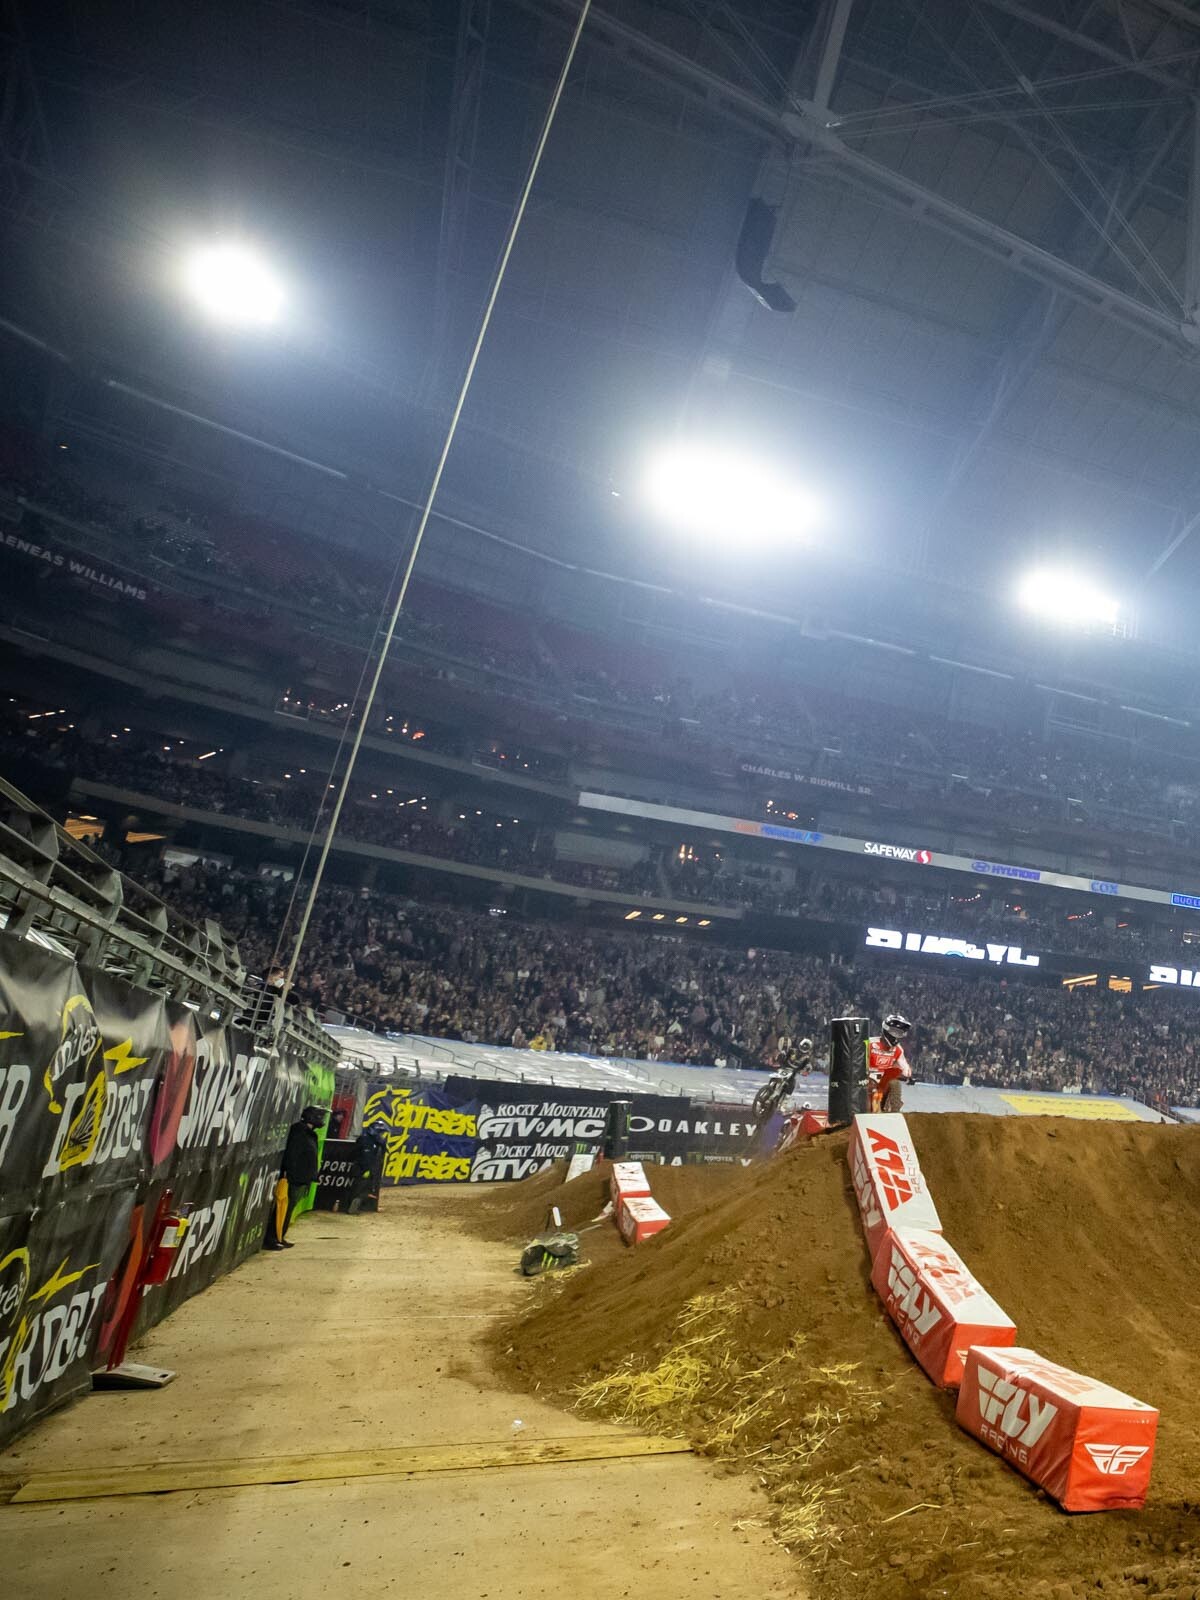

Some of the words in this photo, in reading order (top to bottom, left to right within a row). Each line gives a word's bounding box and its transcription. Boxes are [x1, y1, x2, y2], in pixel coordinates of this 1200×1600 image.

[69, 560, 147, 601] WILLIAMS
[741, 763, 791, 780] CHARLES
[863, 842, 917, 861] SAFEWAY
[991, 864, 1041, 881] HYUNDAI
[1090, 880, 1119, 895] COX
[496, 1103, 538, 1118] ROCKY
[538, 1102, 609, 1119] MOUNTAIN
[658, 1118, 757, 1137] OAKLEY
[888, 1246, 942, 1336] FLY
[977, 1364, 1059, 1448] FLY
[979, 1424, 1029, 1465] RACING
